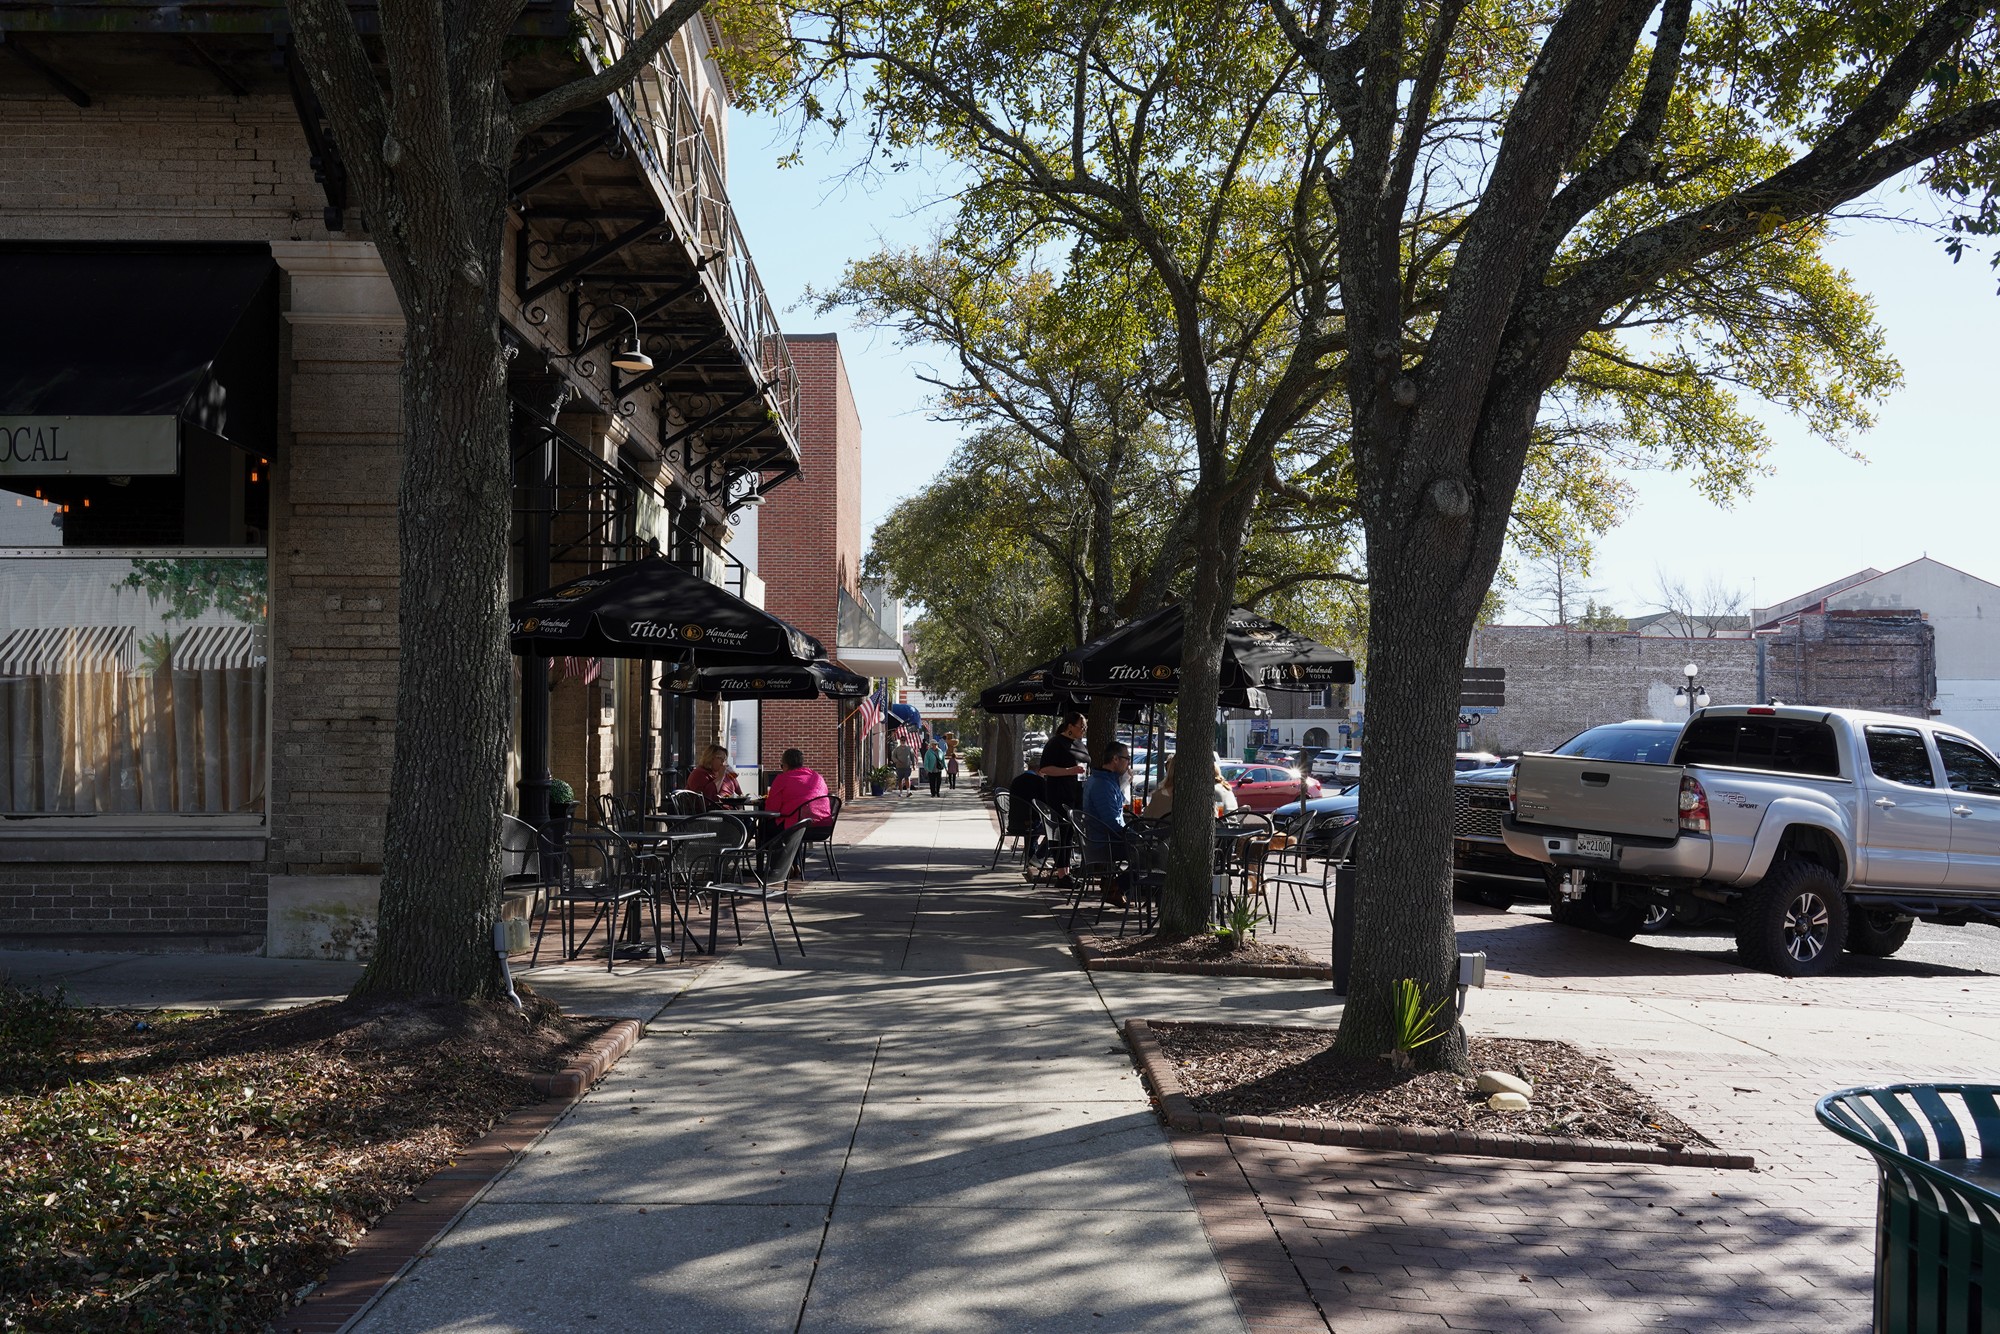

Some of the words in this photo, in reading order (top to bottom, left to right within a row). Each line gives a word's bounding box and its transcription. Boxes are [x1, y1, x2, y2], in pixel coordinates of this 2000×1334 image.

[0, 426, 69, 463] OCAL
[630, 620, 679, 640] Tito's
[706, 627, 748, 640] Handmade
[711, 637, 742, 646] VODKA
[1108, 664, 1150, 680] Tito's
[1259, 665, 1288, 680] Tito's
[1306, 665, 1333, 674] Handmade
[721, 679, 750, 690] Tito's
[998, 693, 1022, 703] Tito's
[1718, 793, 1747, 805] TRD
